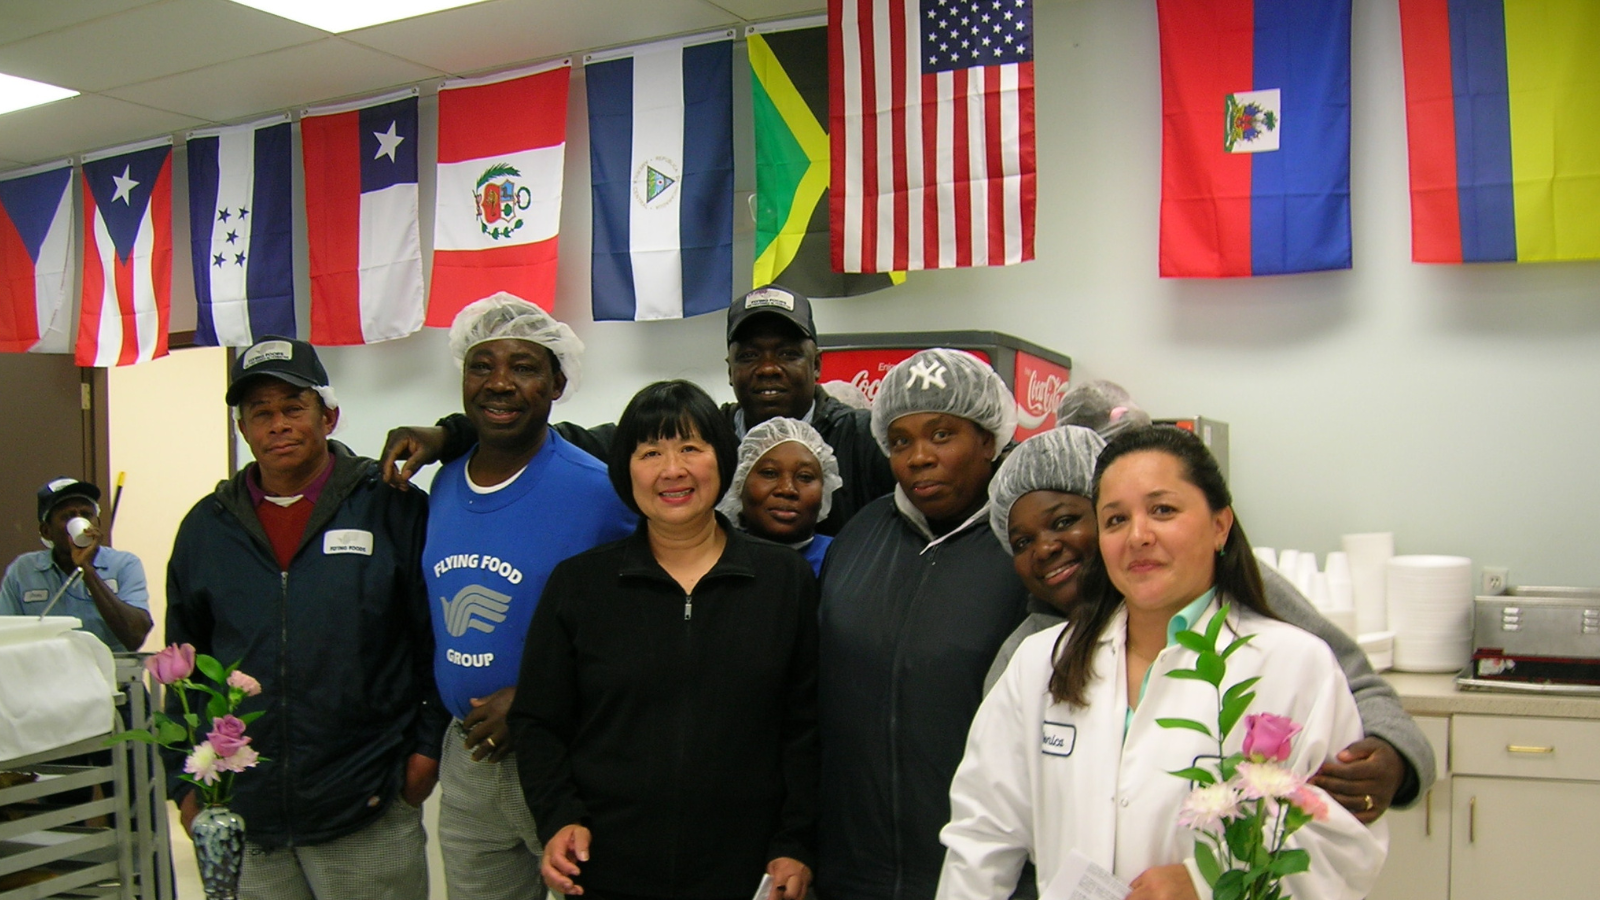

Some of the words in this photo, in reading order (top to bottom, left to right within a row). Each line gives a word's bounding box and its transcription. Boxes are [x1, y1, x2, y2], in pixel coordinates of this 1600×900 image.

[878, 362, 896, 371] Enj
[434, 554, 479, 578] FLYING
[480, 555, 523, 584] FOOD
[446, 648, 494, 667] GROUP
